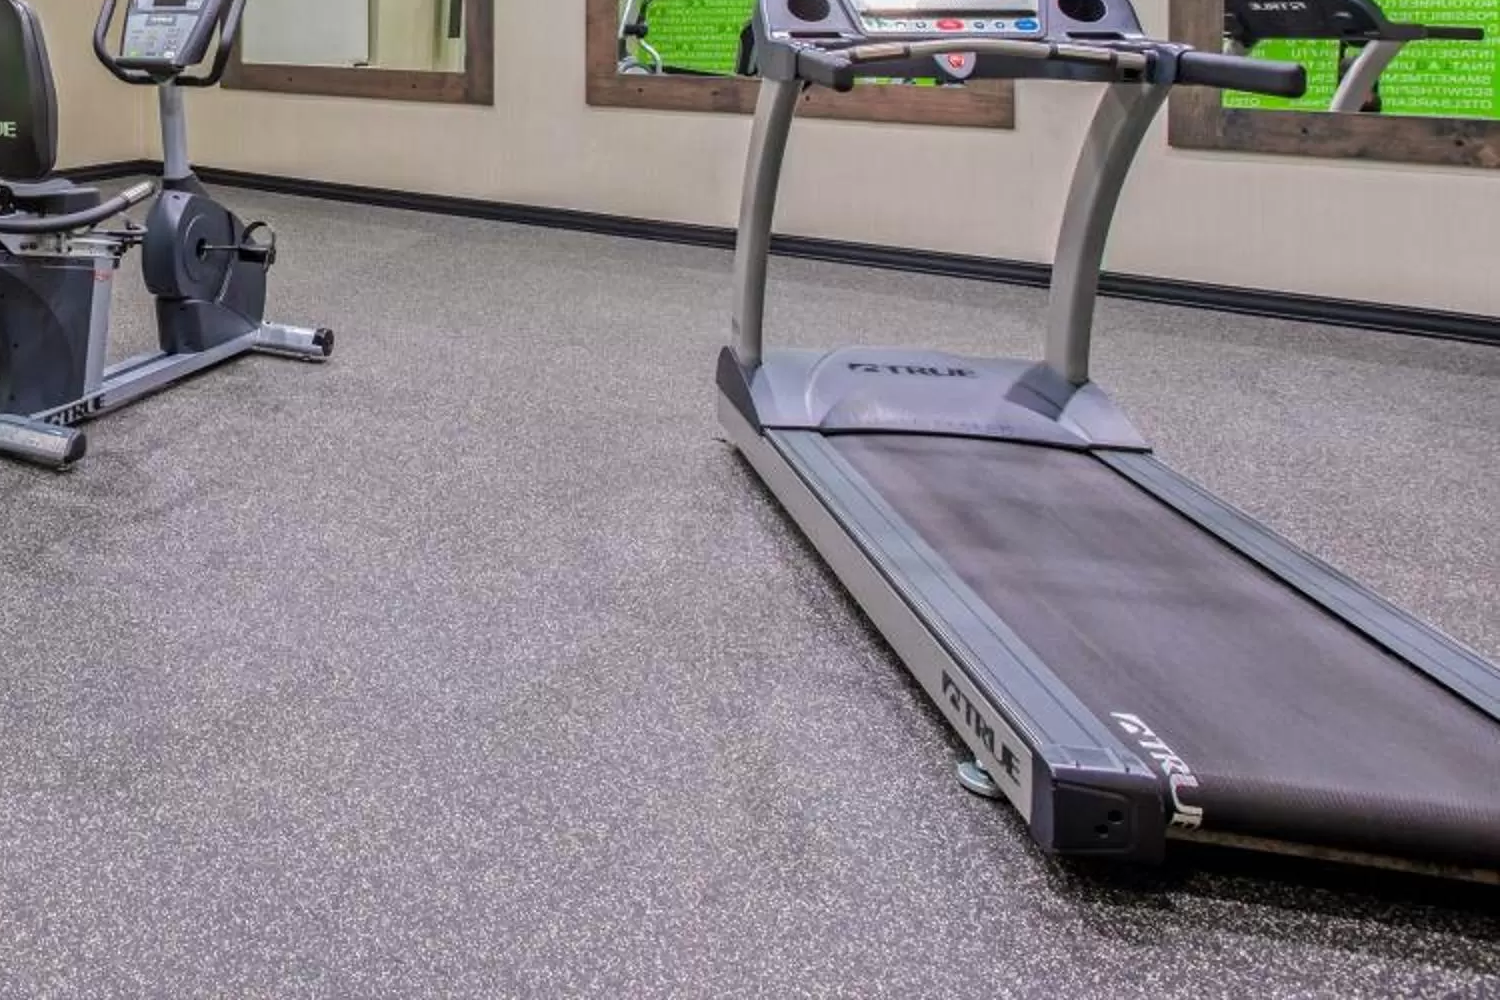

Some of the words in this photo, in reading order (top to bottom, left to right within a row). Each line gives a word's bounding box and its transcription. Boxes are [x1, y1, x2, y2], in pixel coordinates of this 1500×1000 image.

[882, 364, 980, 379] TRUE
[61, 393, 106, 424] TRUE
[961, 697, 1022, 788] TRUE
[1139, 736, 1203, 830] TRUE
